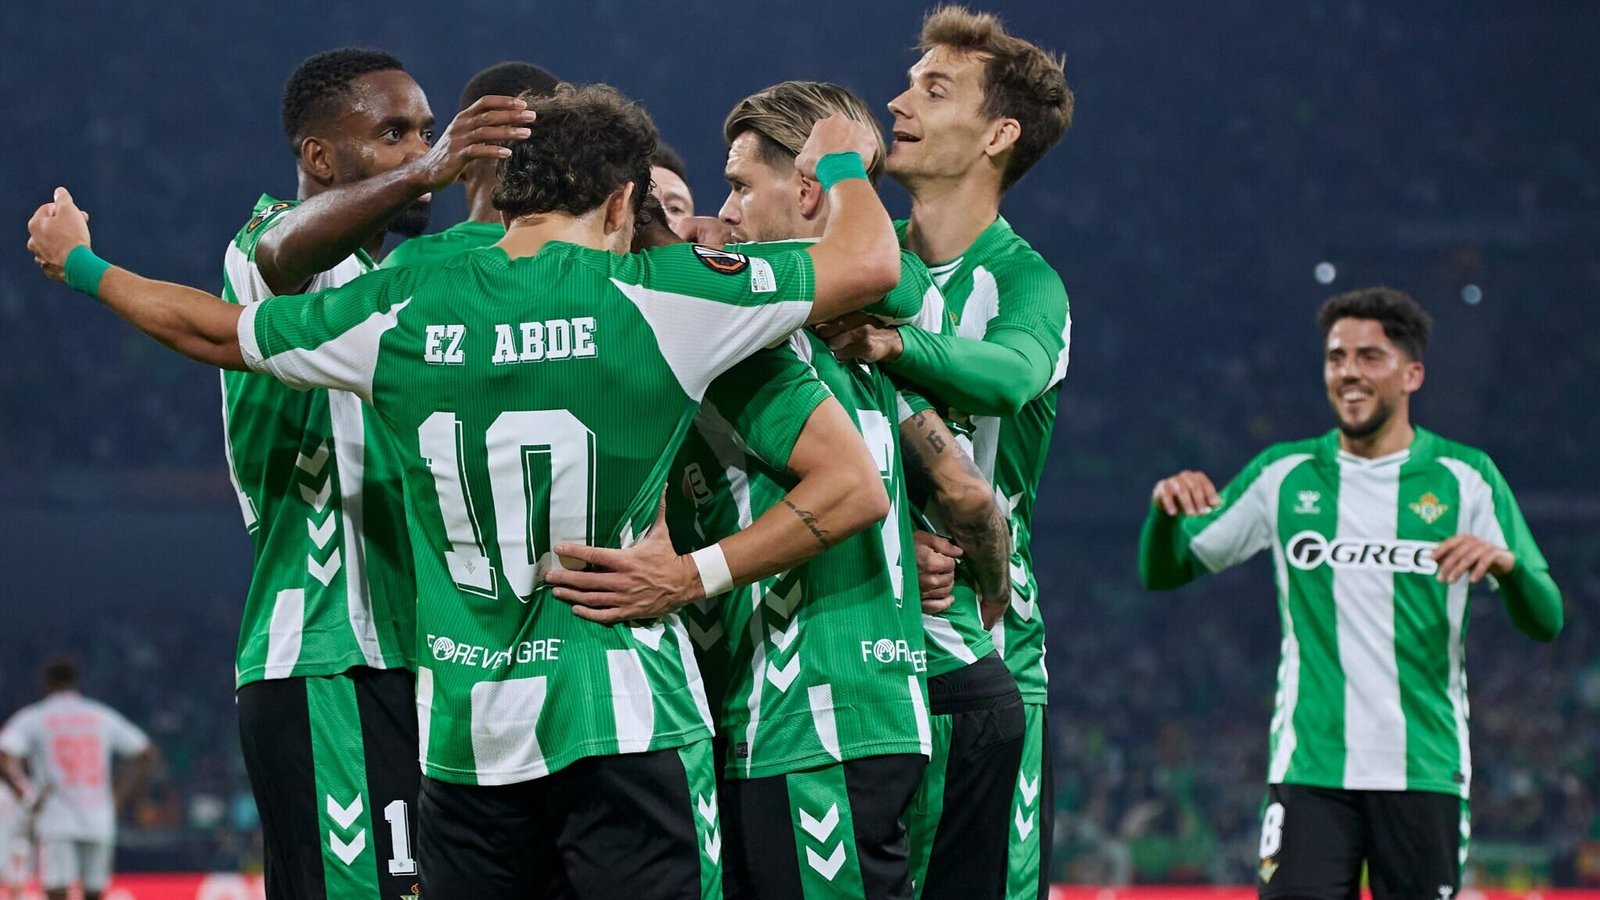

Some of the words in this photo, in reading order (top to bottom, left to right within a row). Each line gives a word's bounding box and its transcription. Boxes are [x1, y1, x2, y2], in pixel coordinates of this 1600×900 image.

[424, 323, 466, 366] EZ
[491, 316, 598, 366] ABDE
[417, 408, 597, 604] 10
[1259, 802, 1285, 859] 8
